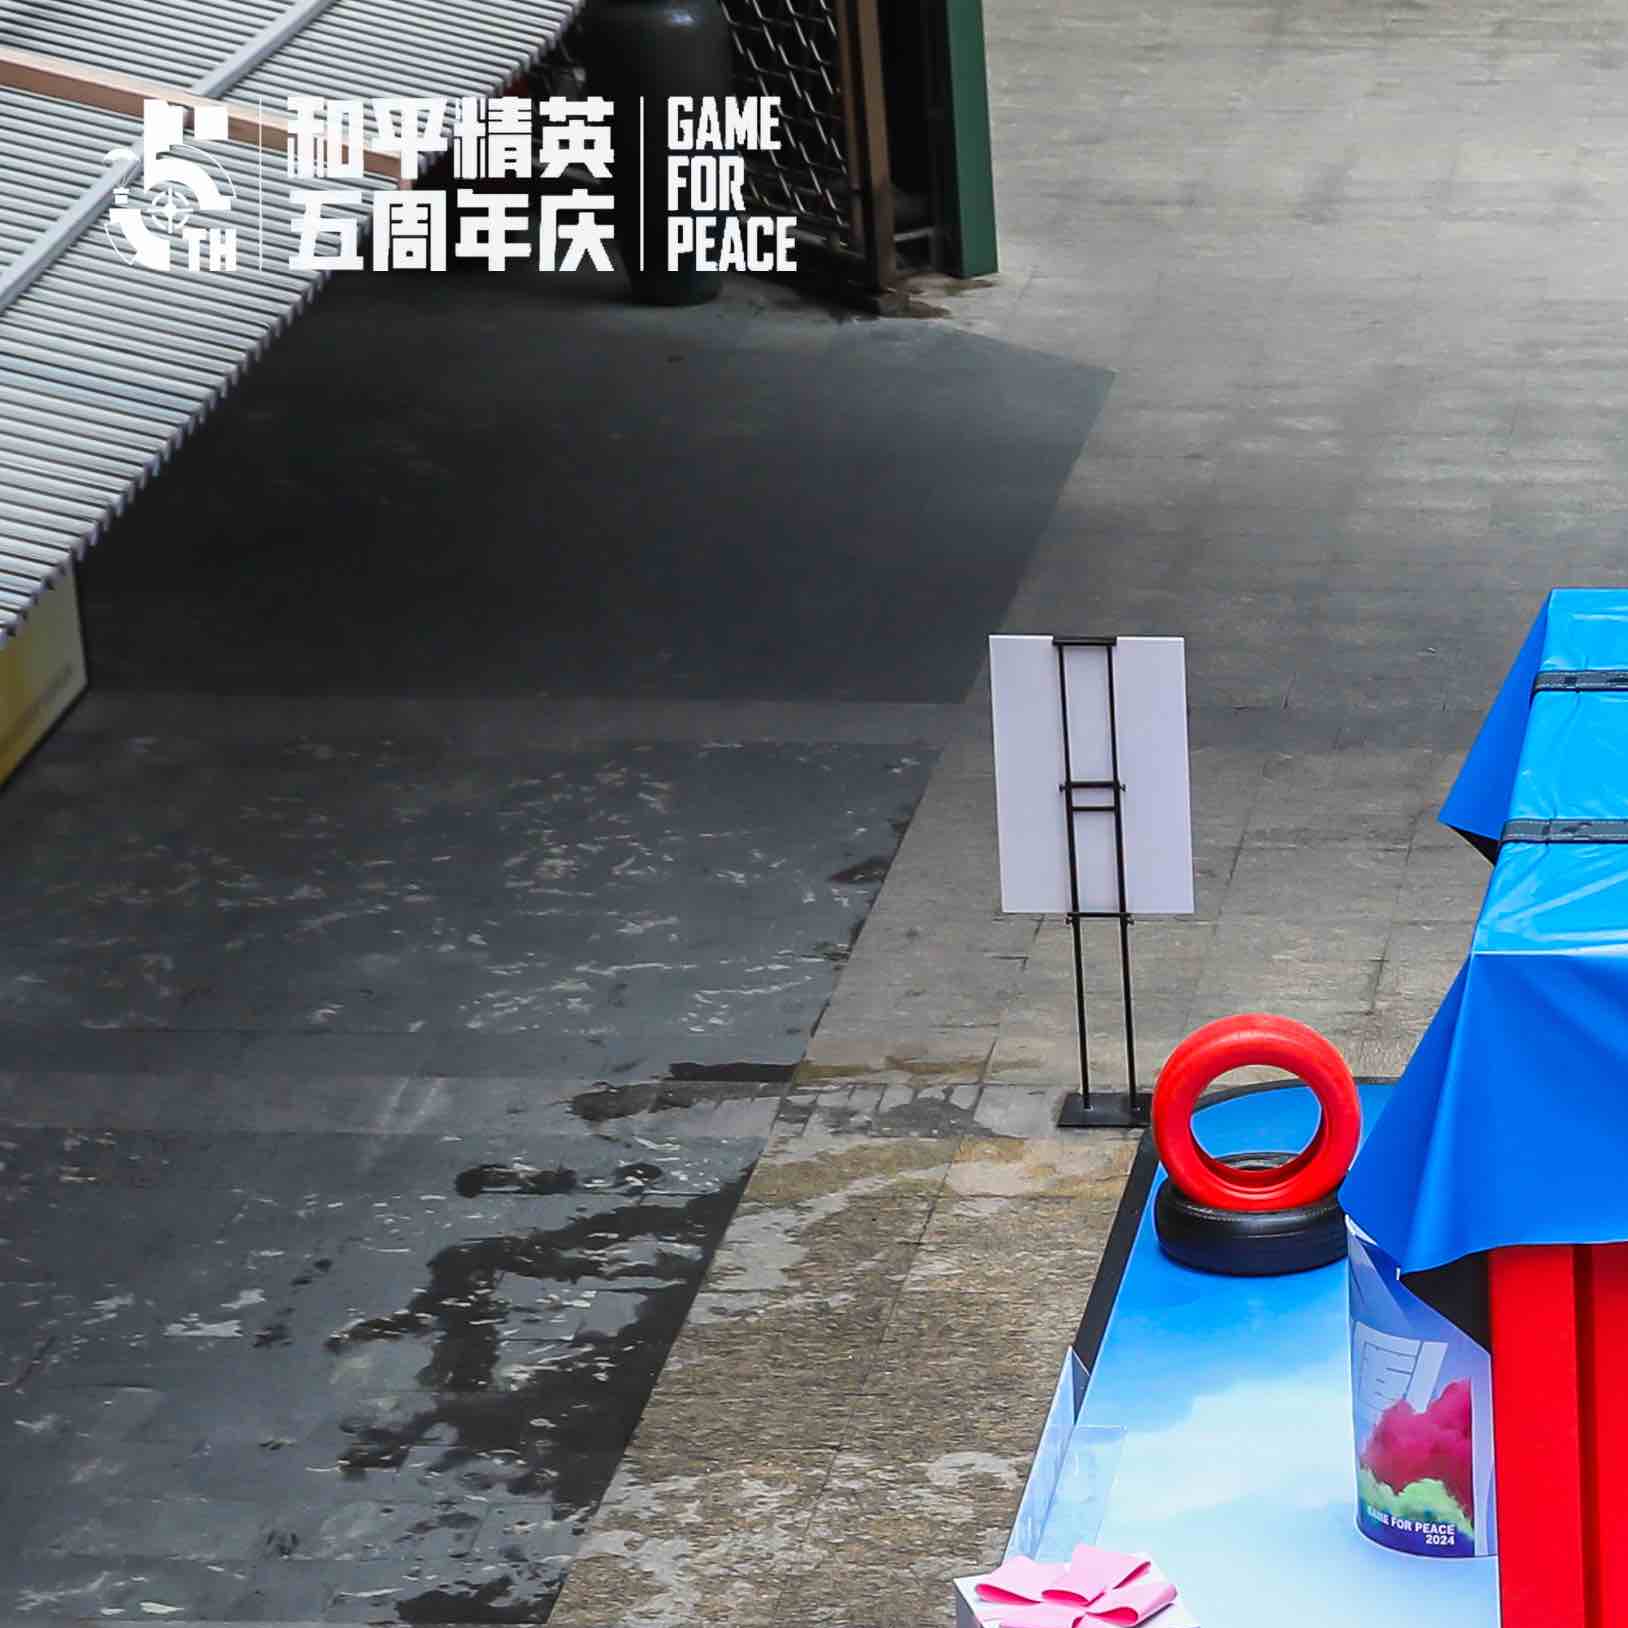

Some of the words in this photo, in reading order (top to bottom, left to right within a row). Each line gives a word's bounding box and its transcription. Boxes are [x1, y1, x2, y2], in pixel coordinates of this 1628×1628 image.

[1391, 1518, 1413, 1532] FOR
[1414, 1522, 1456, 1536] PEACE
[1425, 1534, 1456, 1546] 2024
